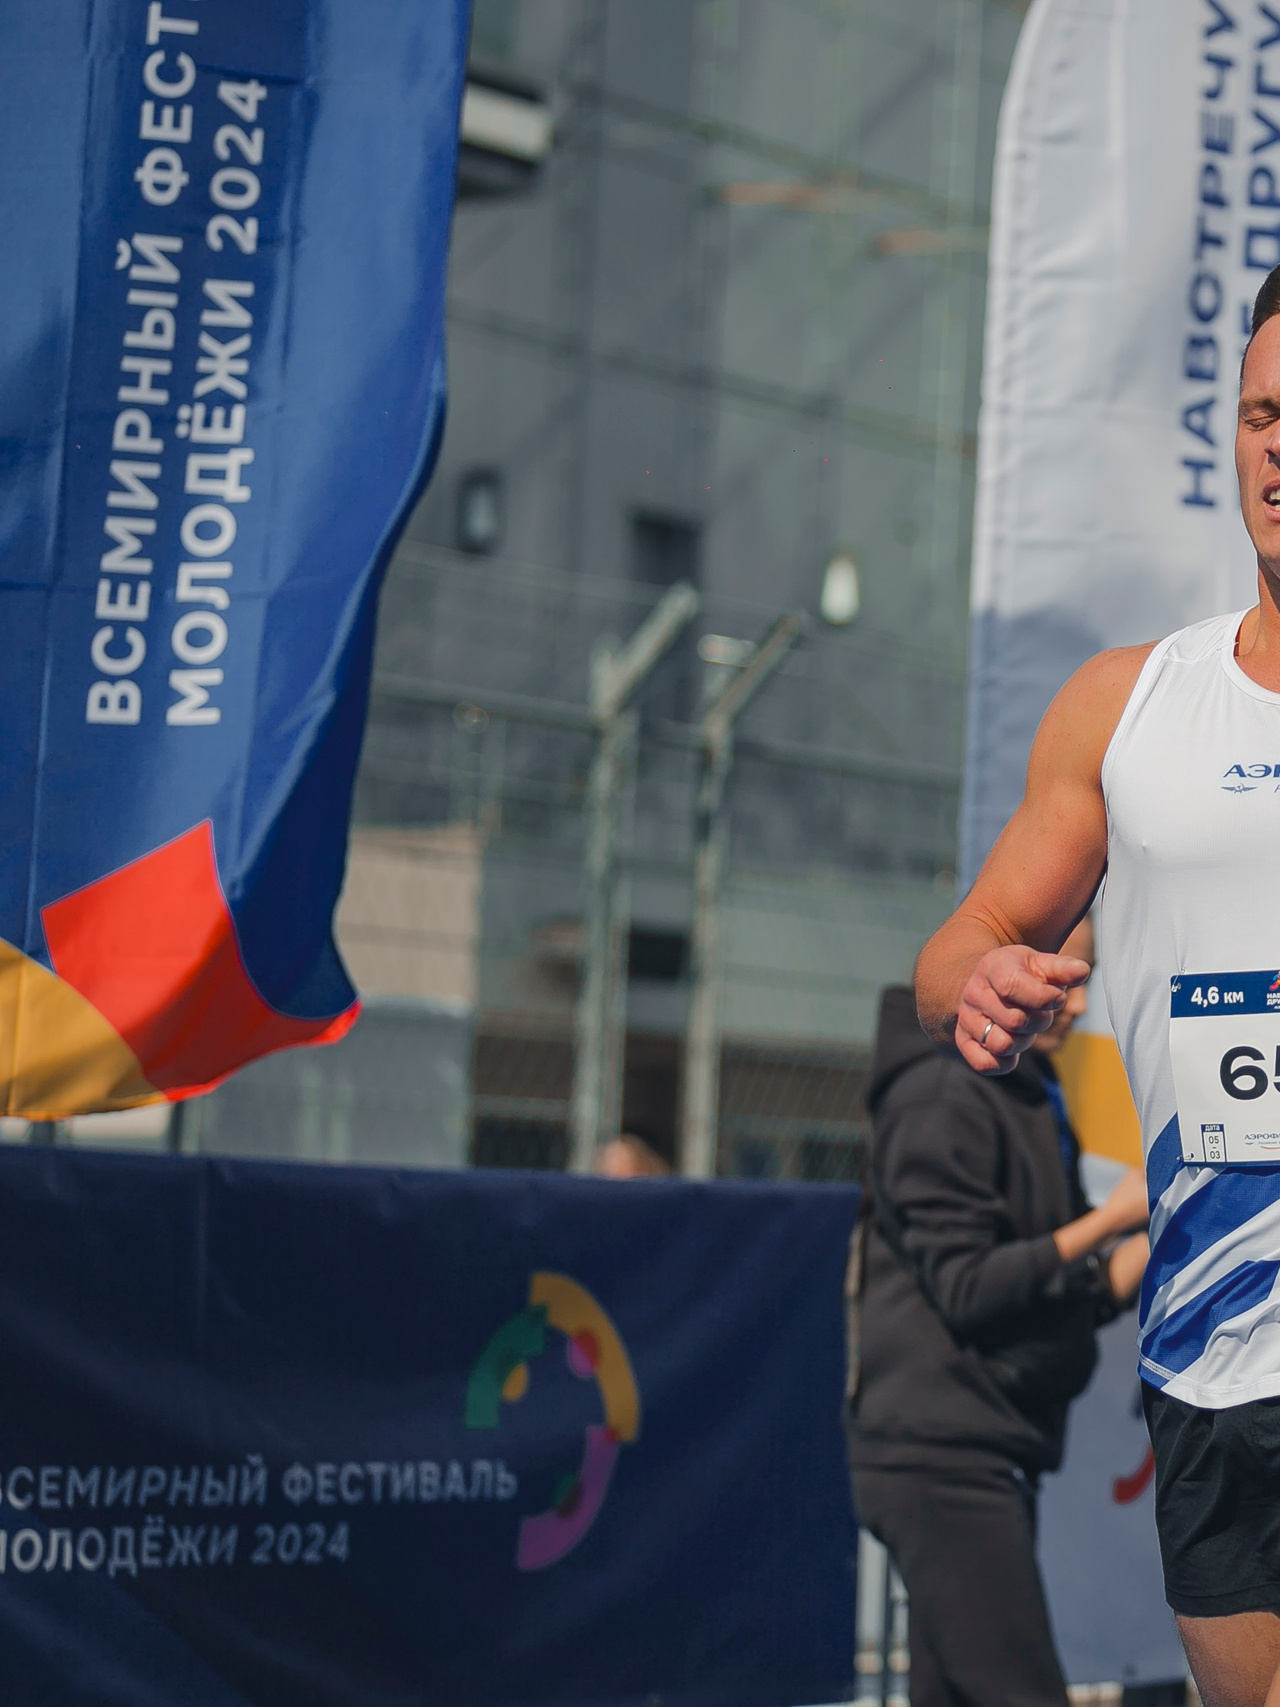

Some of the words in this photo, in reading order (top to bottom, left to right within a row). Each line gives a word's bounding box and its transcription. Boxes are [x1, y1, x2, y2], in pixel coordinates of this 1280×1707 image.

[205, 79, 267, 255] 2024
[86, 232, 184, 726] ВСЕМИРНЫЙ
[166, 279, 256, 727] МОЛОДЁЖИ
[1190, 986, 1219, 1008] 4,6
[1208, 1135, 1220, 1145] 05
[1209, 1150, 1221, 1160] 03
[0, 1453, 268, 1511] СЕМИРНЫЙ
[281, 1459, 518, 1503] ФЕСТИВАЛЬ
[0, 1514, 240, 1578] ОЛОДЁЖИ
[250, 1521, 350, 1565] 2024
